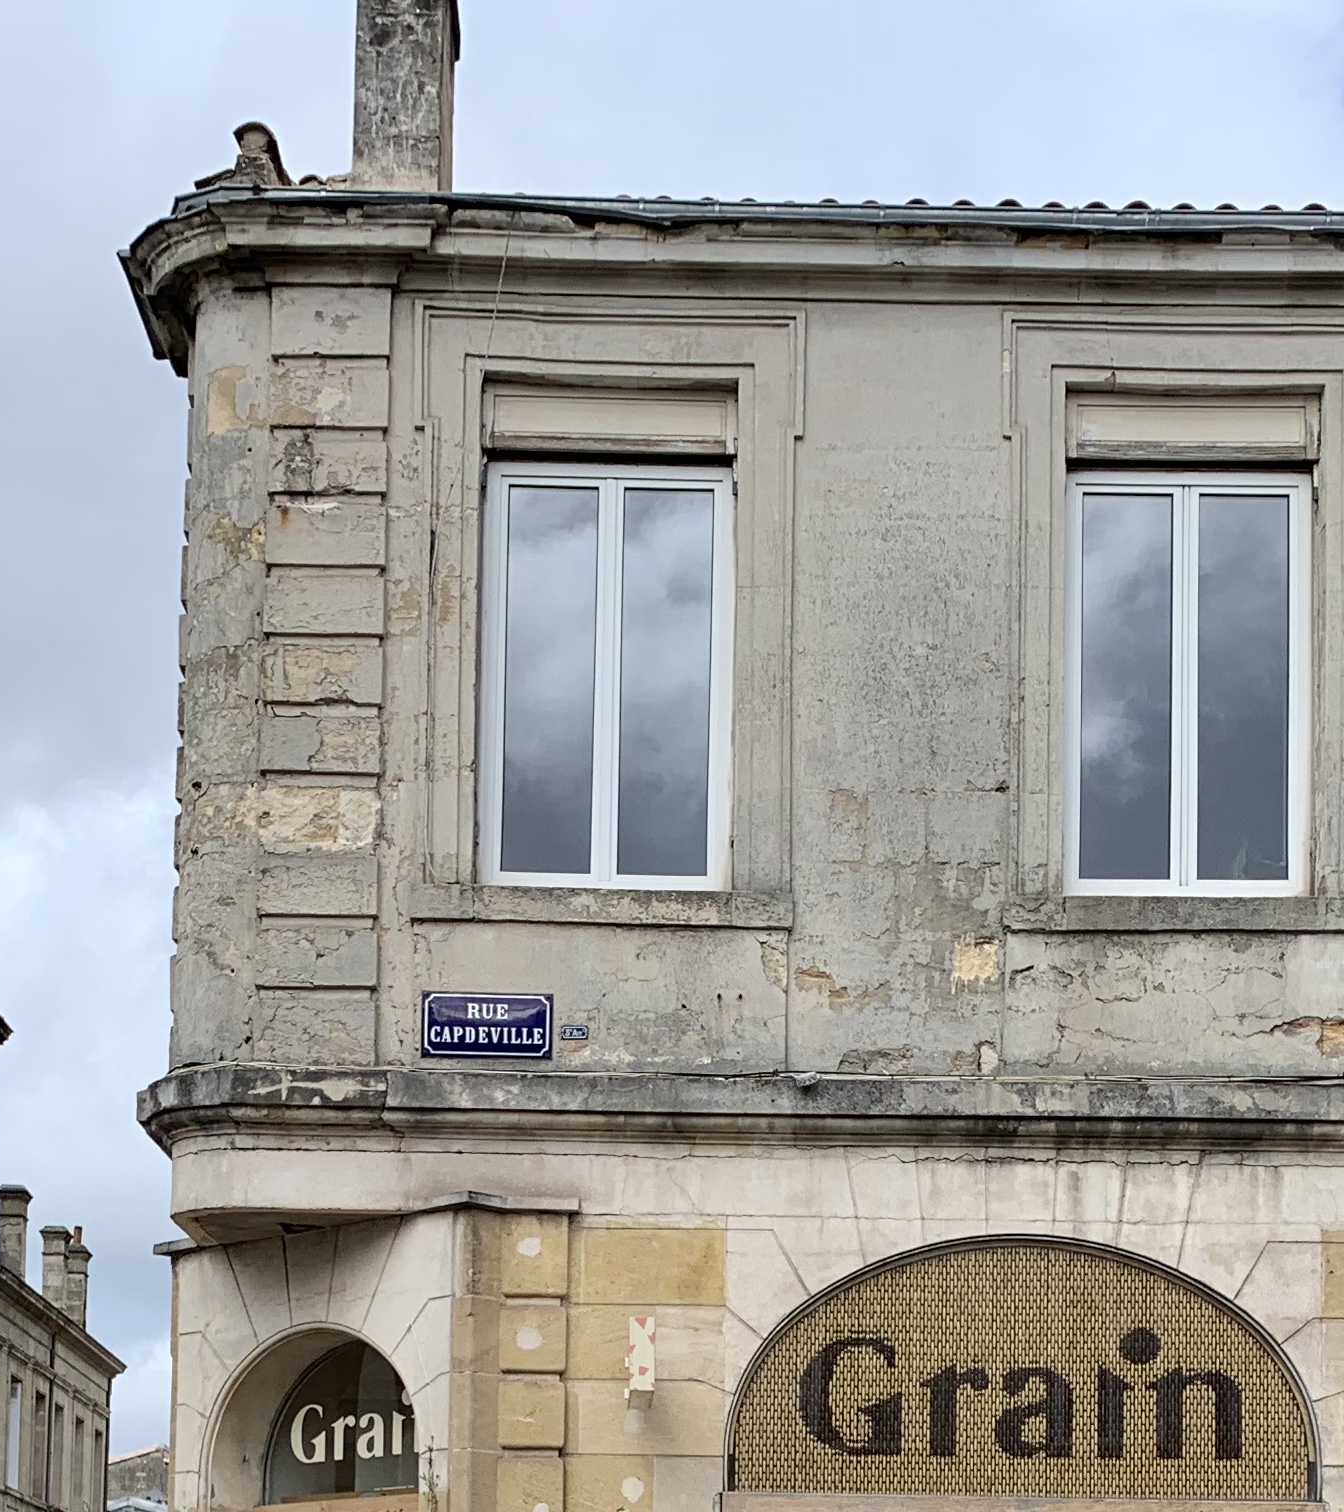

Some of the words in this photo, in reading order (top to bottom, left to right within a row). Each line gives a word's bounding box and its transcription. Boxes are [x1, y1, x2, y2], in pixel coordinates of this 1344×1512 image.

[467, 1003, 508, 1019] RUE
[430, 1026, 543, 1044] CAPDEVILLE
[797, 1327, 1243, 1460] Grain
